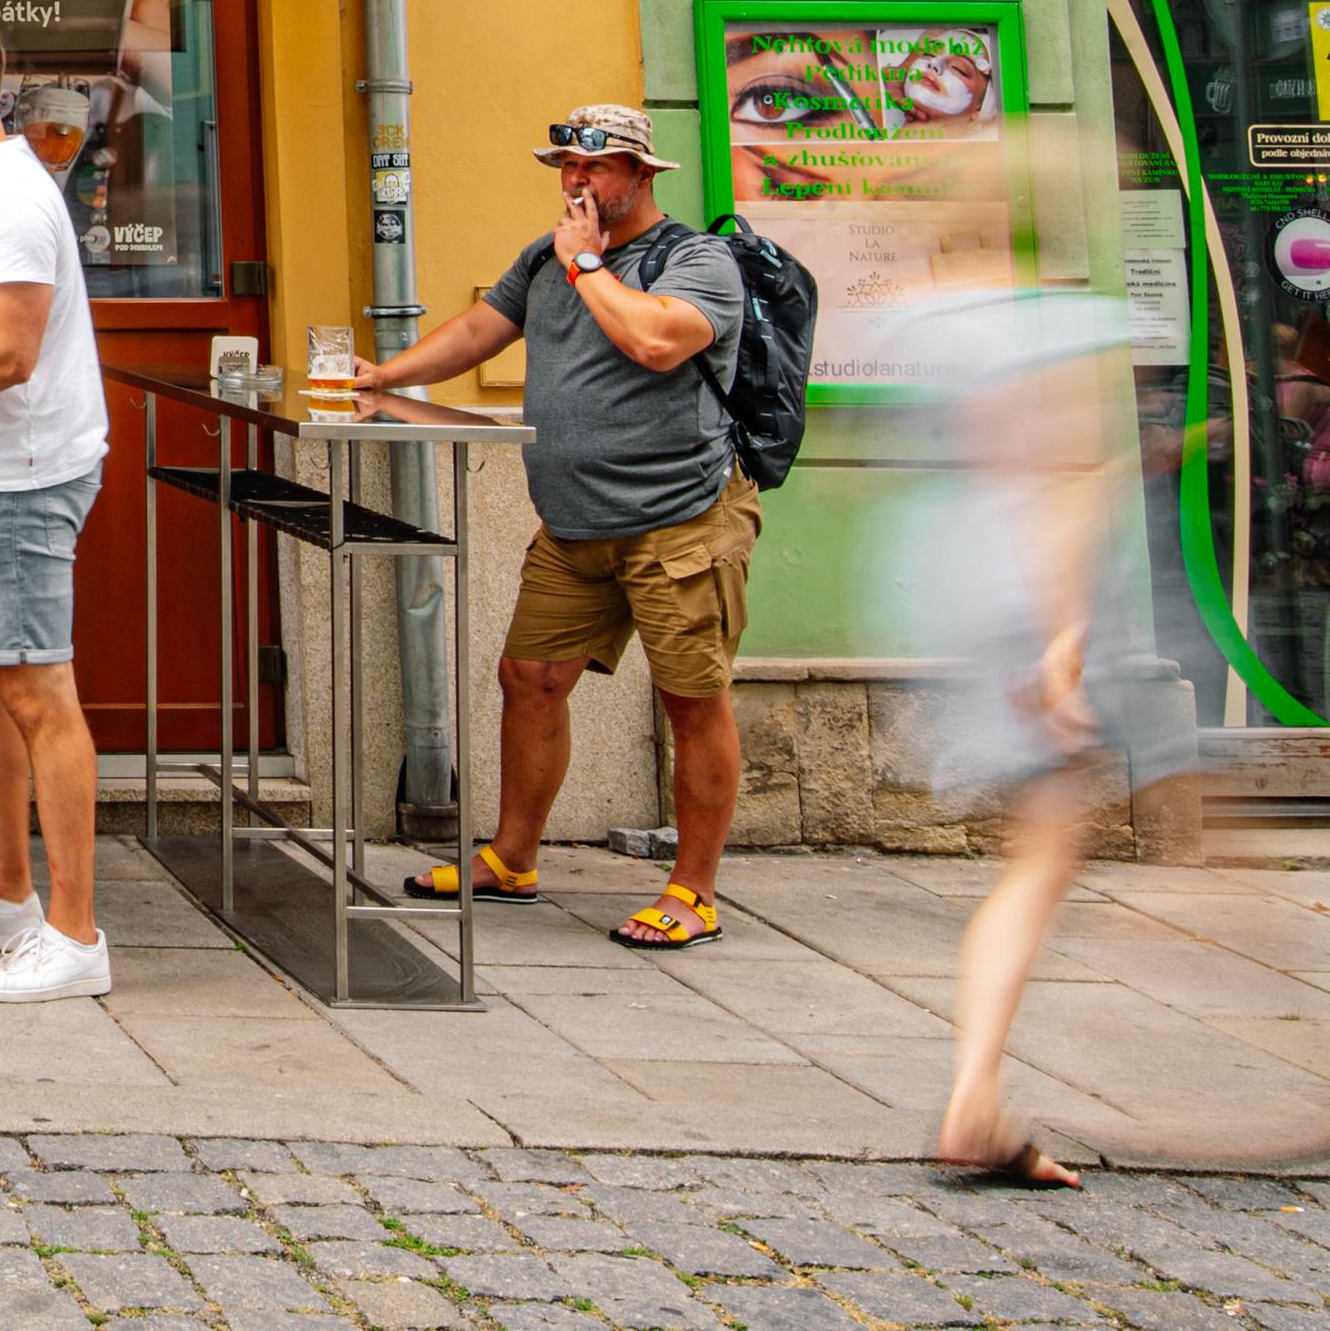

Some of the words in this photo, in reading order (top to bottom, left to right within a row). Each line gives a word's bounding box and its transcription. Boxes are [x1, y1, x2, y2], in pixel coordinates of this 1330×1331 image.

[751, 34, 863, 55] Nehtová
[772, 91, 914, 112] Kosmetika
[1256, 132, 1310, 144] Provozní
[1261, 149, 1288, 159] podle
[113, 223, 164, 243] VÝČEP
[849, 224, 895, 236] STUDIO
[865, 238, 880, 249] LA
[849, 251, 898, 263] NATURE
[1281, 280, 1300, 298] GET
[1302, 291, 1311, 301] IT
